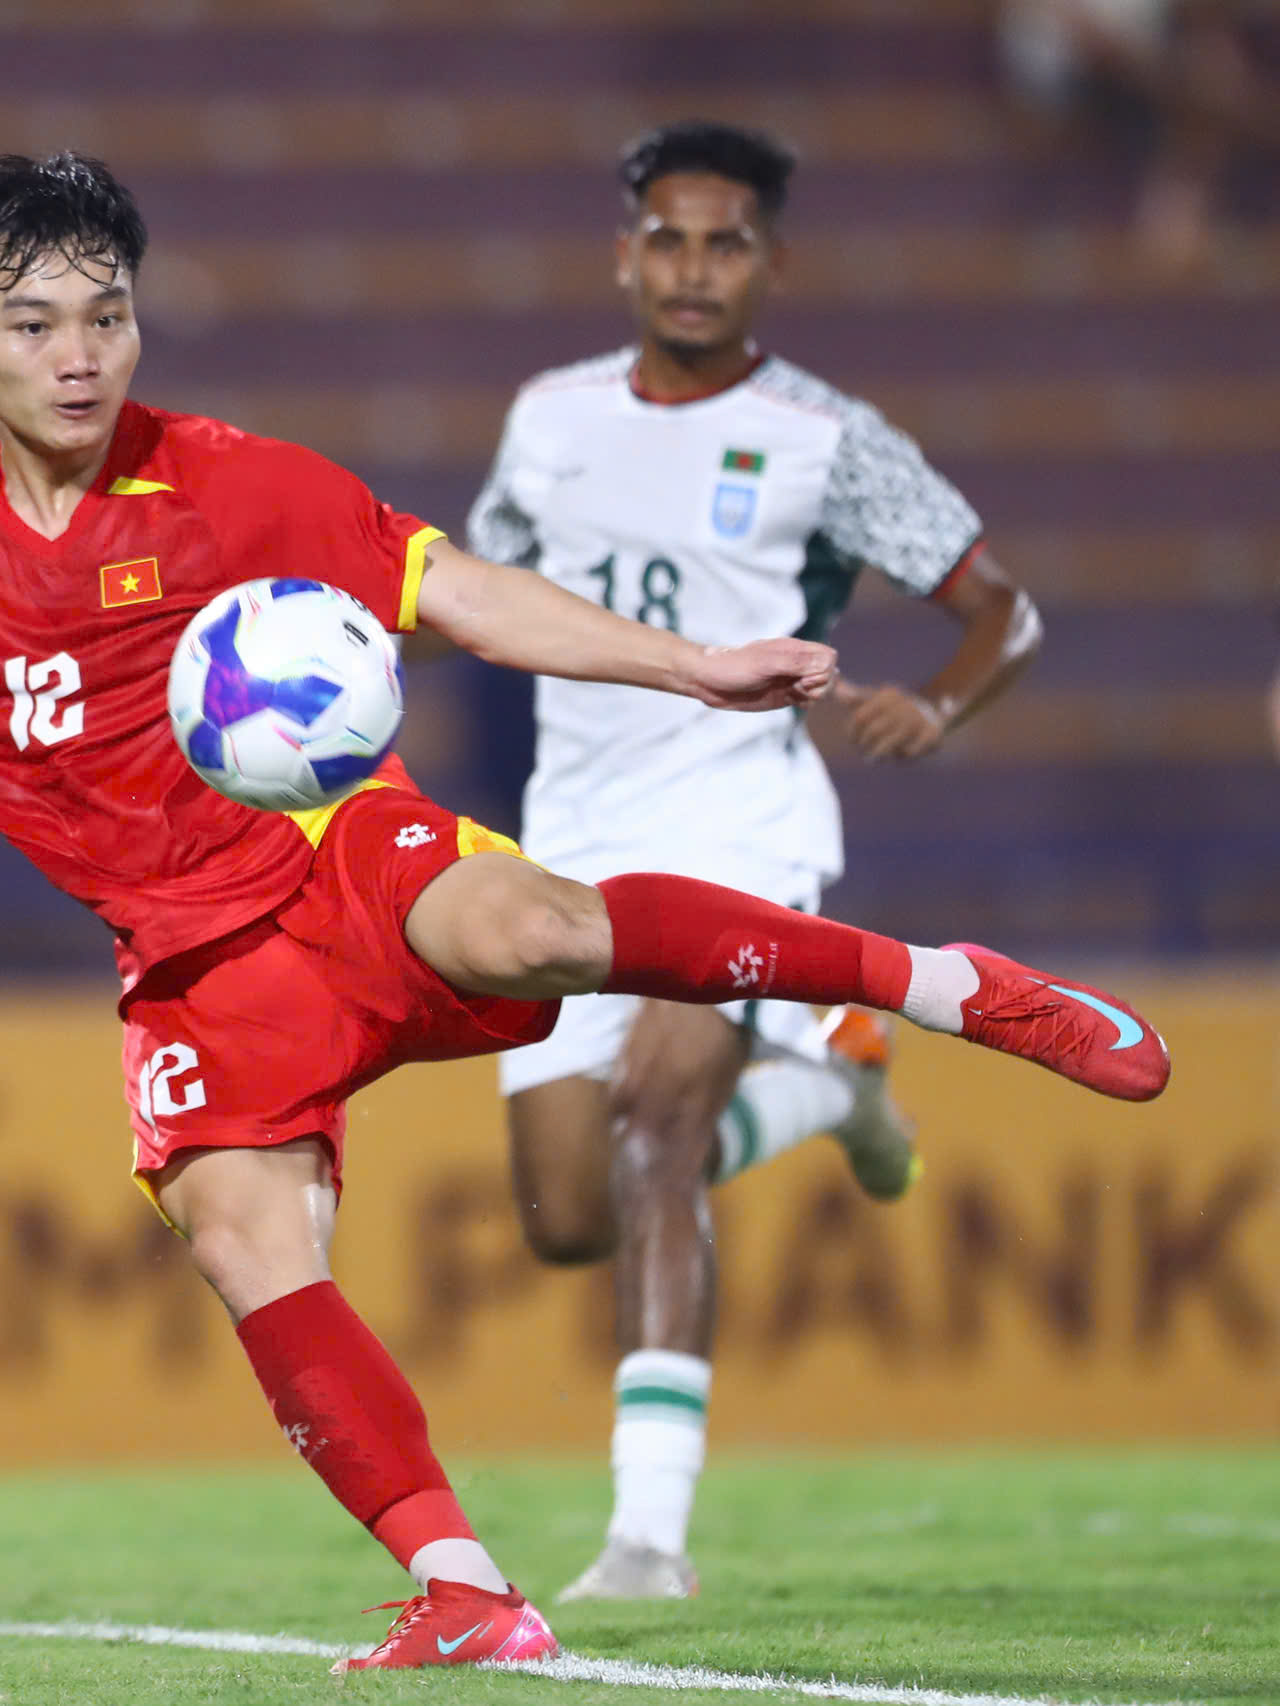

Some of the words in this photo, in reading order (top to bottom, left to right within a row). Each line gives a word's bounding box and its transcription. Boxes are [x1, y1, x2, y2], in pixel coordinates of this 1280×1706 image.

[584, 552, 680, 632] 18
[3, 650, 87, 752] 12
[138, 1041, 208, 1142] 12
